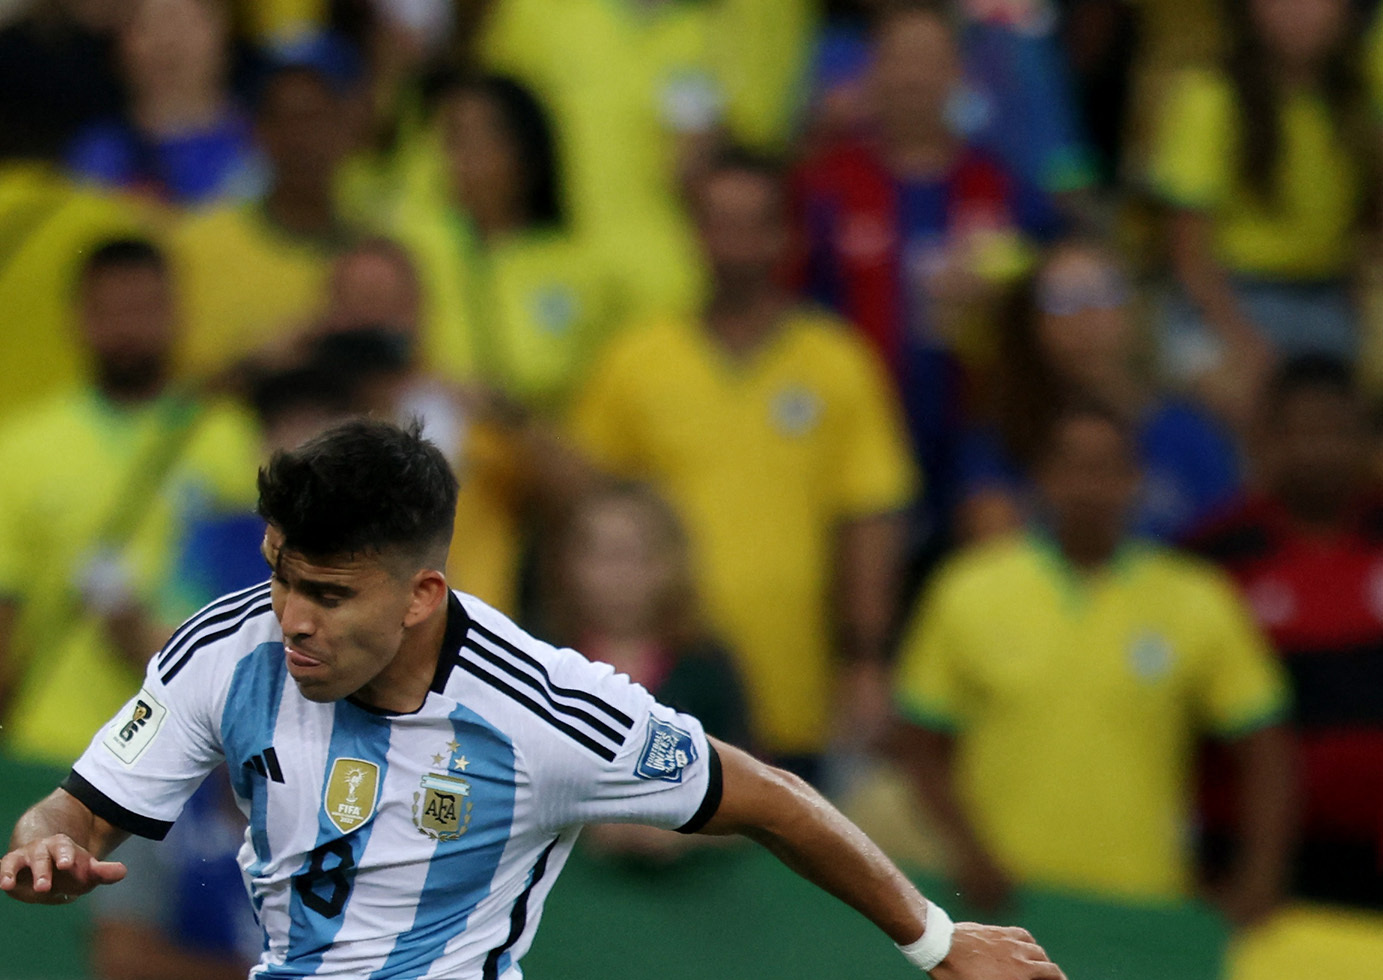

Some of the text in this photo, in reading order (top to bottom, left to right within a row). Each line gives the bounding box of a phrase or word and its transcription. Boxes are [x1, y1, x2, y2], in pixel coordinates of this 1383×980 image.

[645, 731, 662, 766] FOOTBALL
[338, 803, 361, 815] FIFA
[424, 792, 456, 824] AFA
[295, 837, 355, 919] 8
